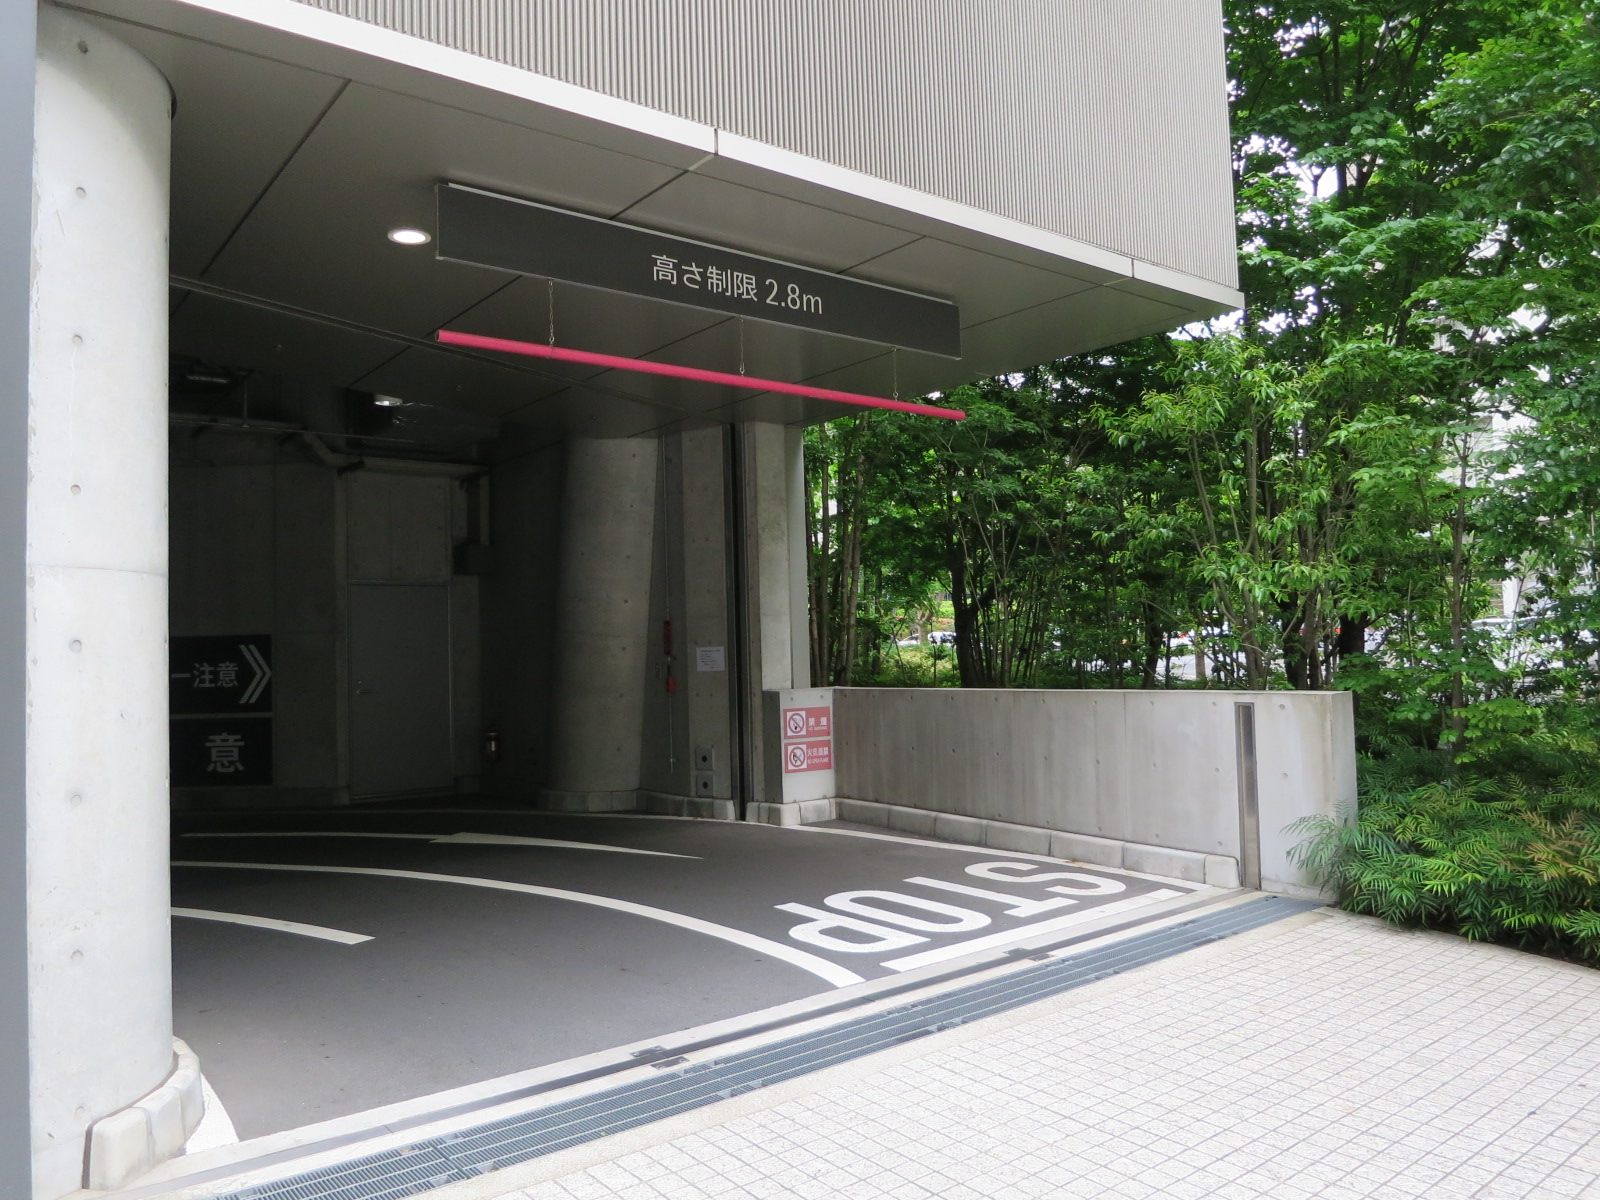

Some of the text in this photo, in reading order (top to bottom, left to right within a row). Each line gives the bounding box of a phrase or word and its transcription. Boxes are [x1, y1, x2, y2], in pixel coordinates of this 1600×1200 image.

[651, 254, 823, 315] 高さ制限 2.8m
[204, 732, 245, 773] 意
[773, 861, 1127, 953] STOP
